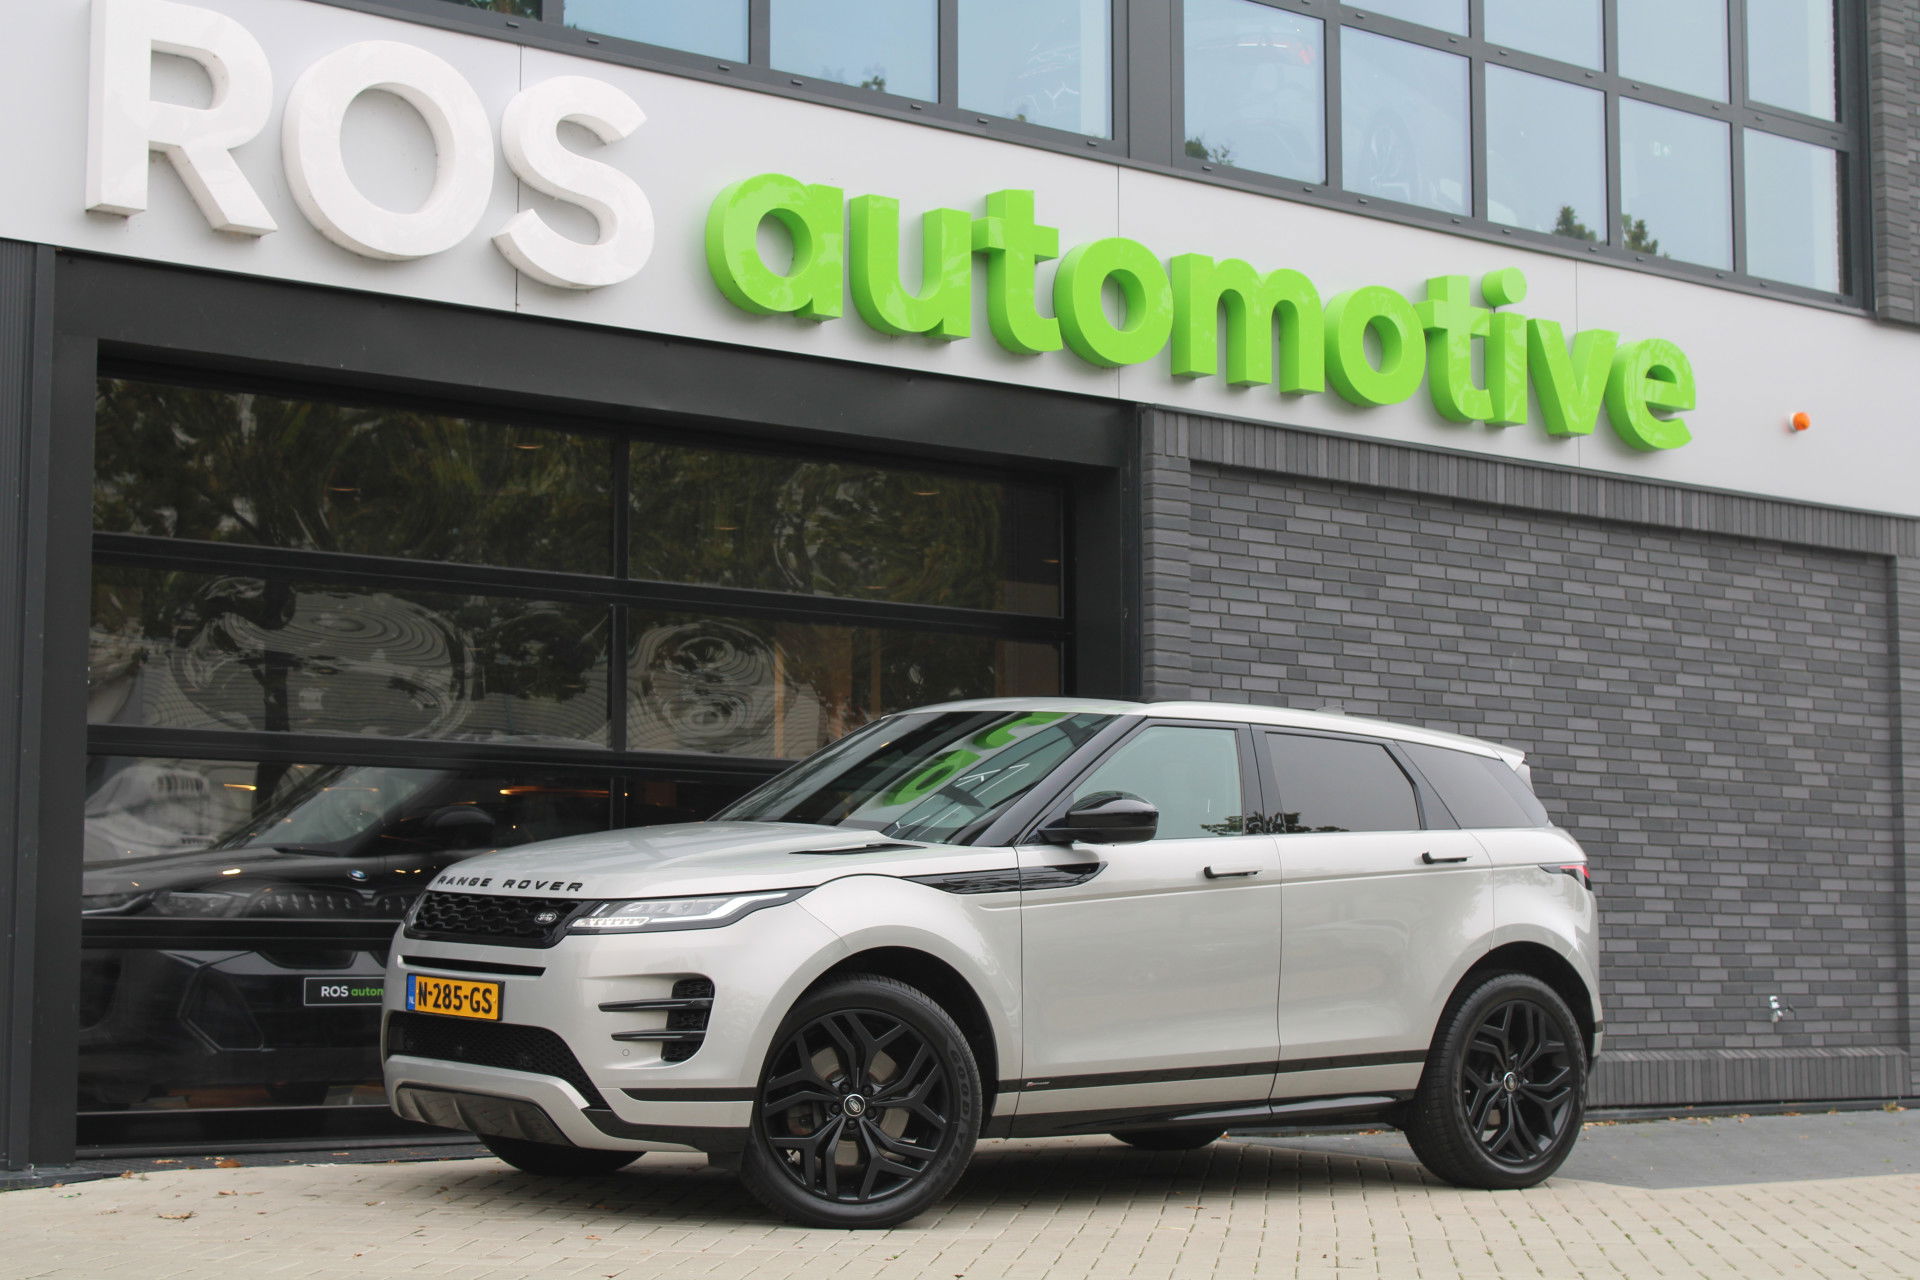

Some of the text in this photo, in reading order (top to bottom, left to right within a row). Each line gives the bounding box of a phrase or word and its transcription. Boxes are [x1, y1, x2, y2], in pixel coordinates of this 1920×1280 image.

[86, 0, 1697, 451] ROS automotive
[437, 875, 583, 892] RANGE ROVER
[321, 985, 349, 998] ROS
[418, 981, 493, 1014] N-285-GS
